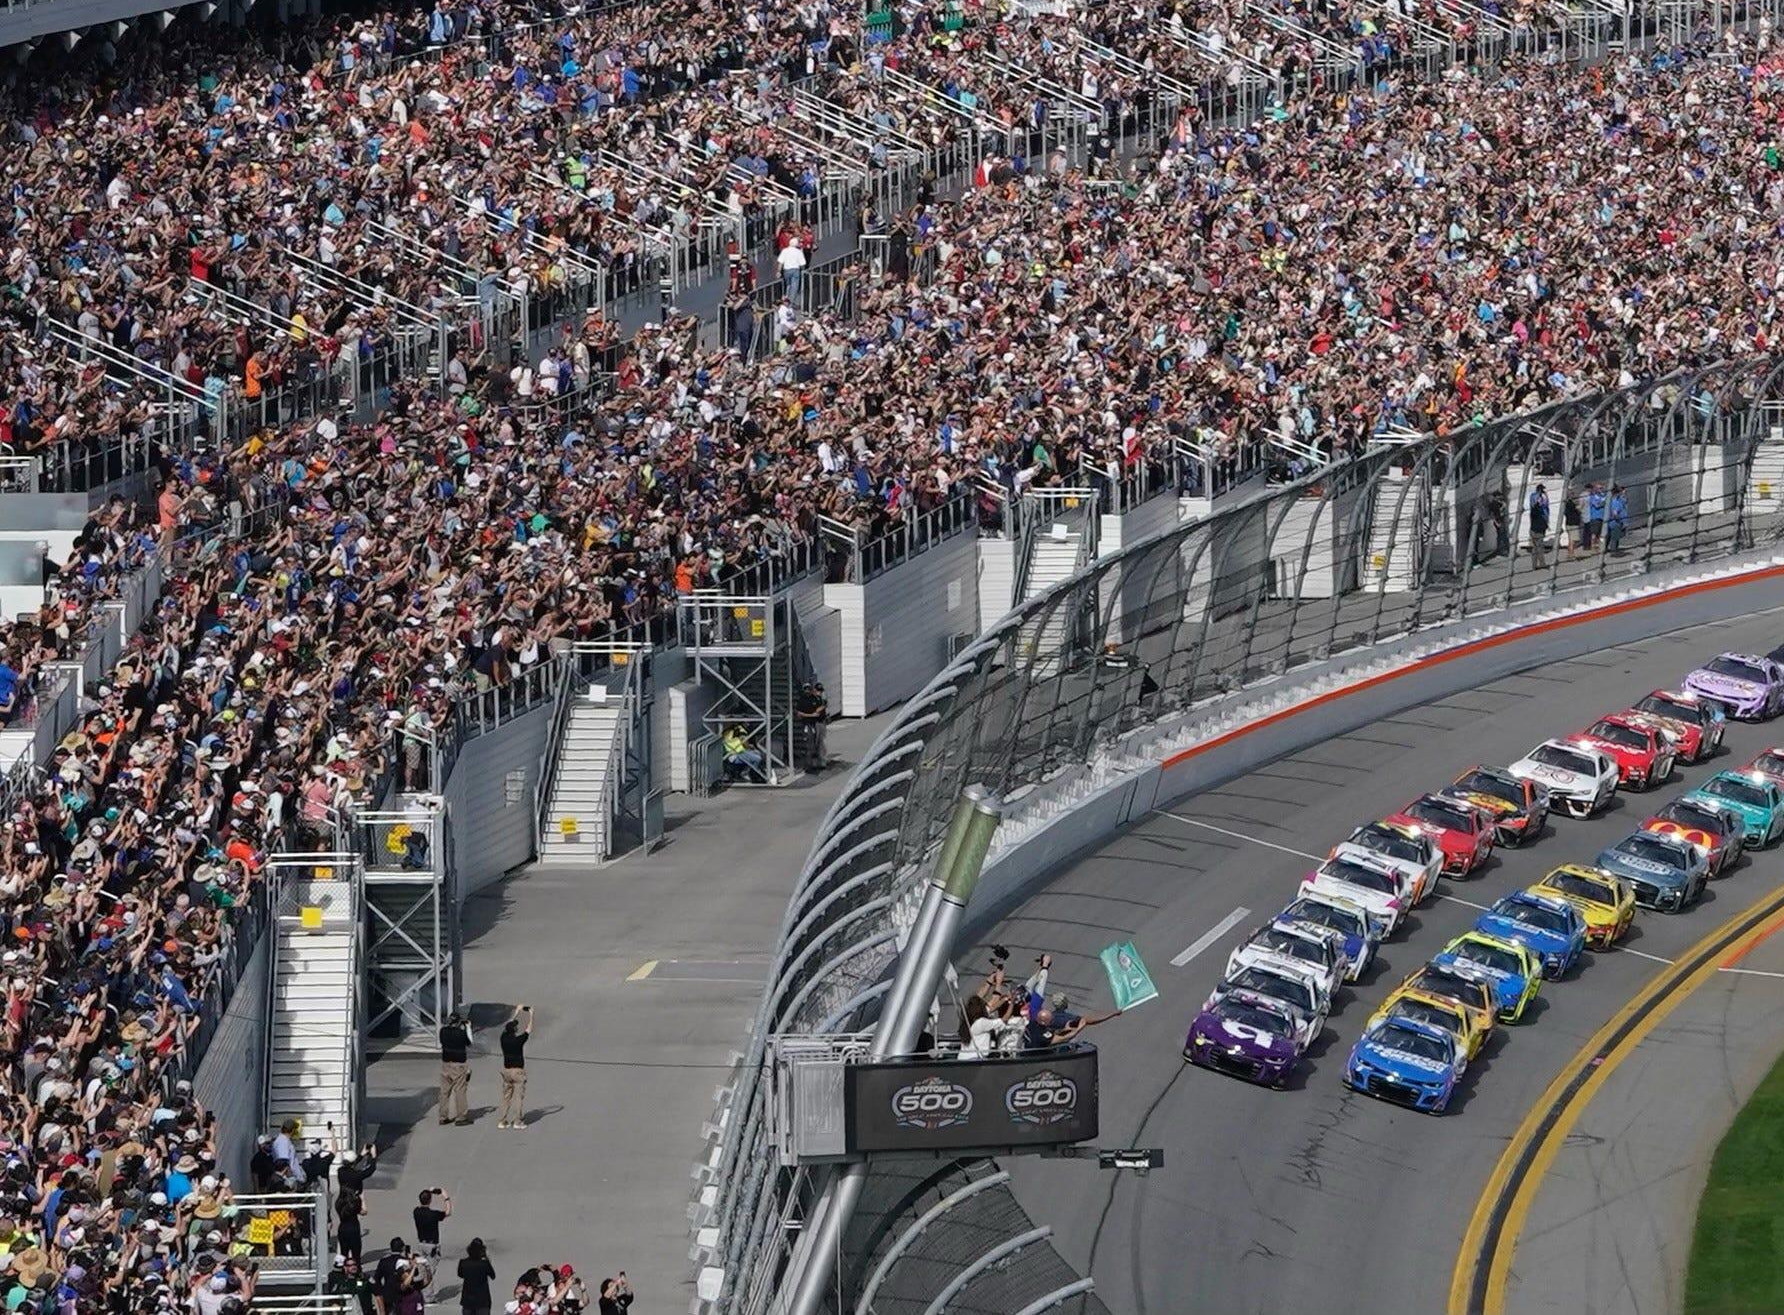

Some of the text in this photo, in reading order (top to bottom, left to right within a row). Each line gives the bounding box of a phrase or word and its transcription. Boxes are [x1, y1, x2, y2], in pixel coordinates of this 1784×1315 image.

[913, 1084, 952, 1093] DAYTONA
[1026, 1079, 1063, 1089] DAYTONA
[899, 1093, 965, 1111] 500
[1013, 1087, 1072, 1106] 500
